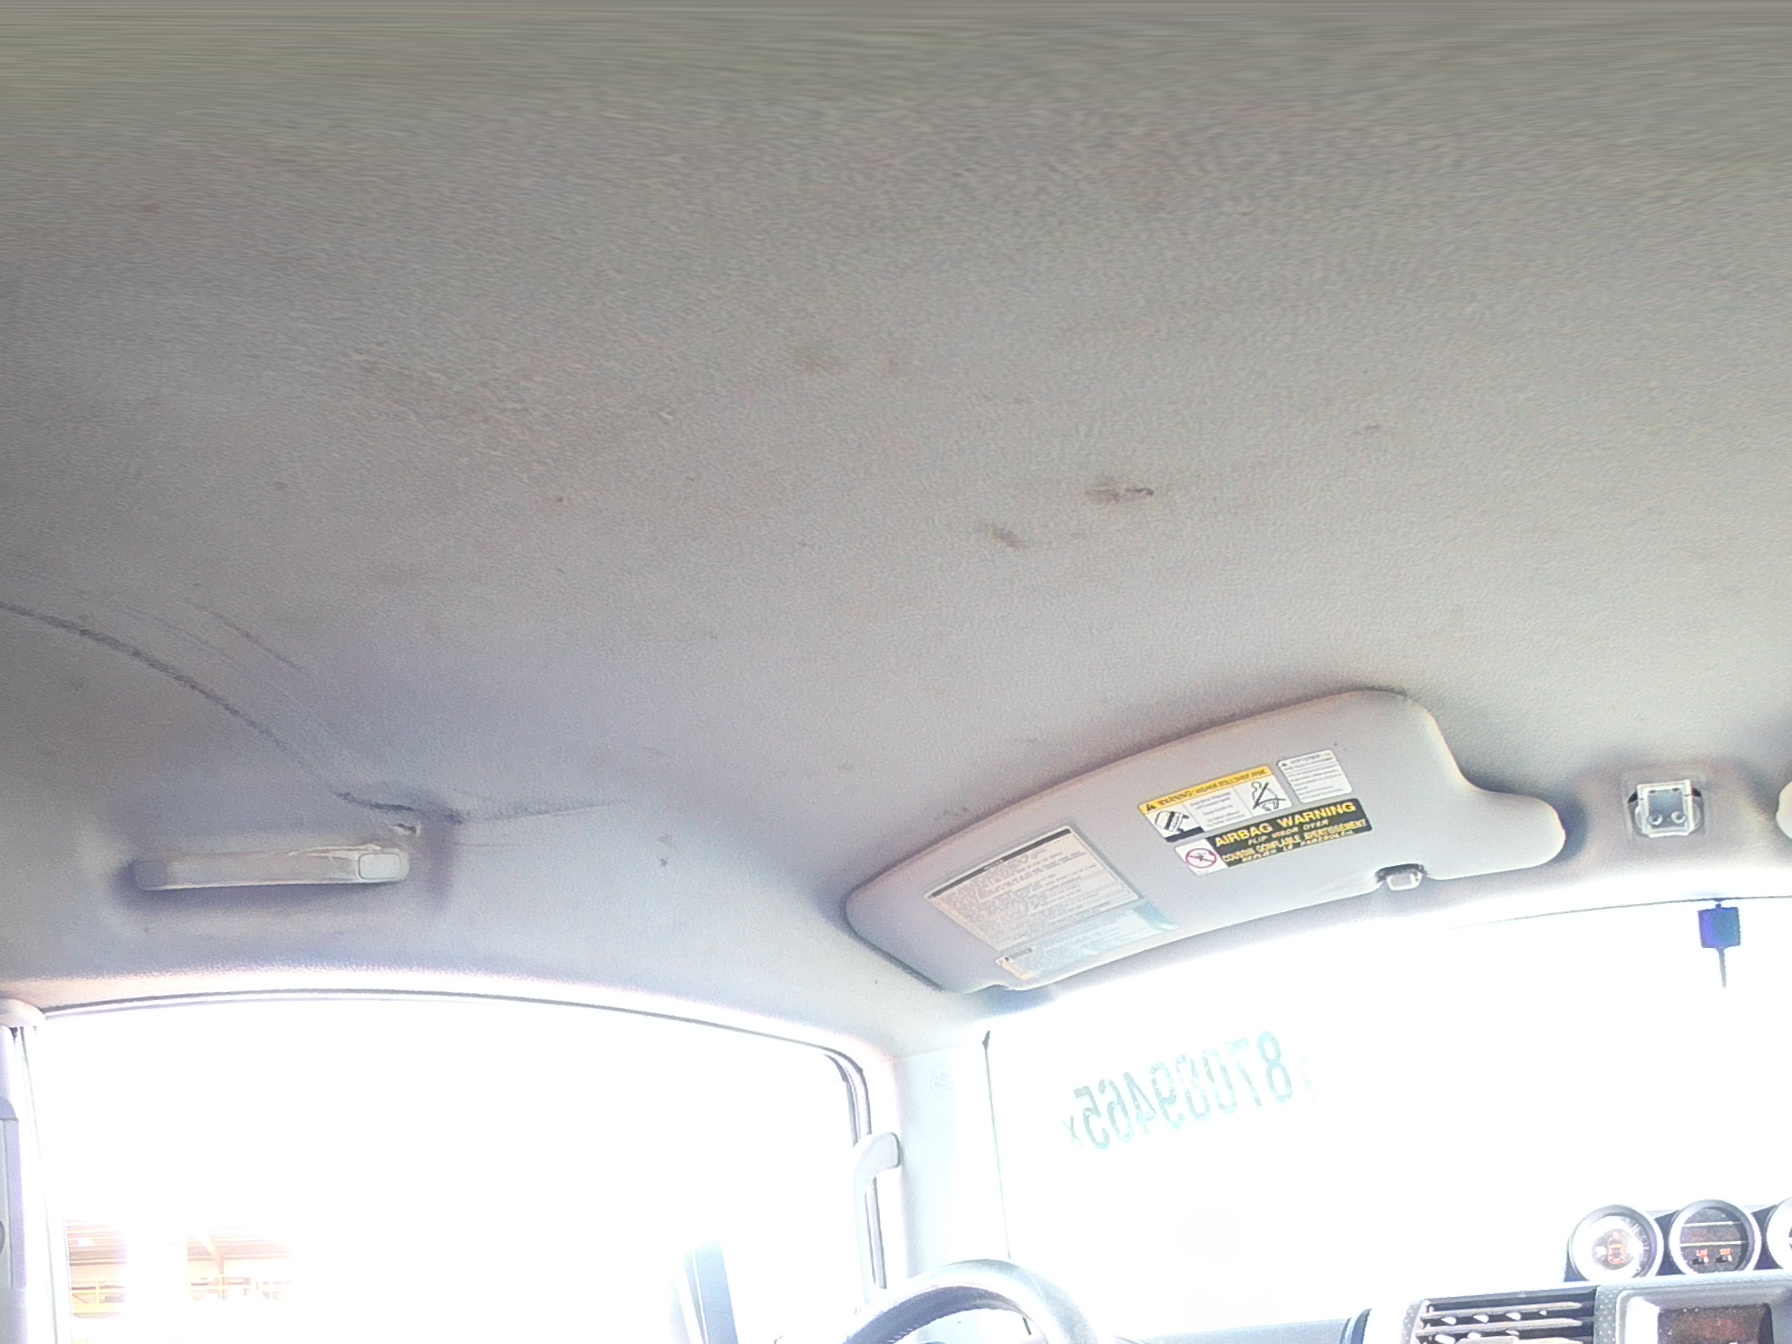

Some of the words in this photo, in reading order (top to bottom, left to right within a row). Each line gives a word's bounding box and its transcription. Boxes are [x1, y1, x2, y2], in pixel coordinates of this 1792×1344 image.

[1215, 822, 1273, 847] AIRBAG
[1276, 802, 1356, 828] WARNING
[1248, 835, 1268, 846] FLIP
[1303, 819, 1330, 831] OVER
